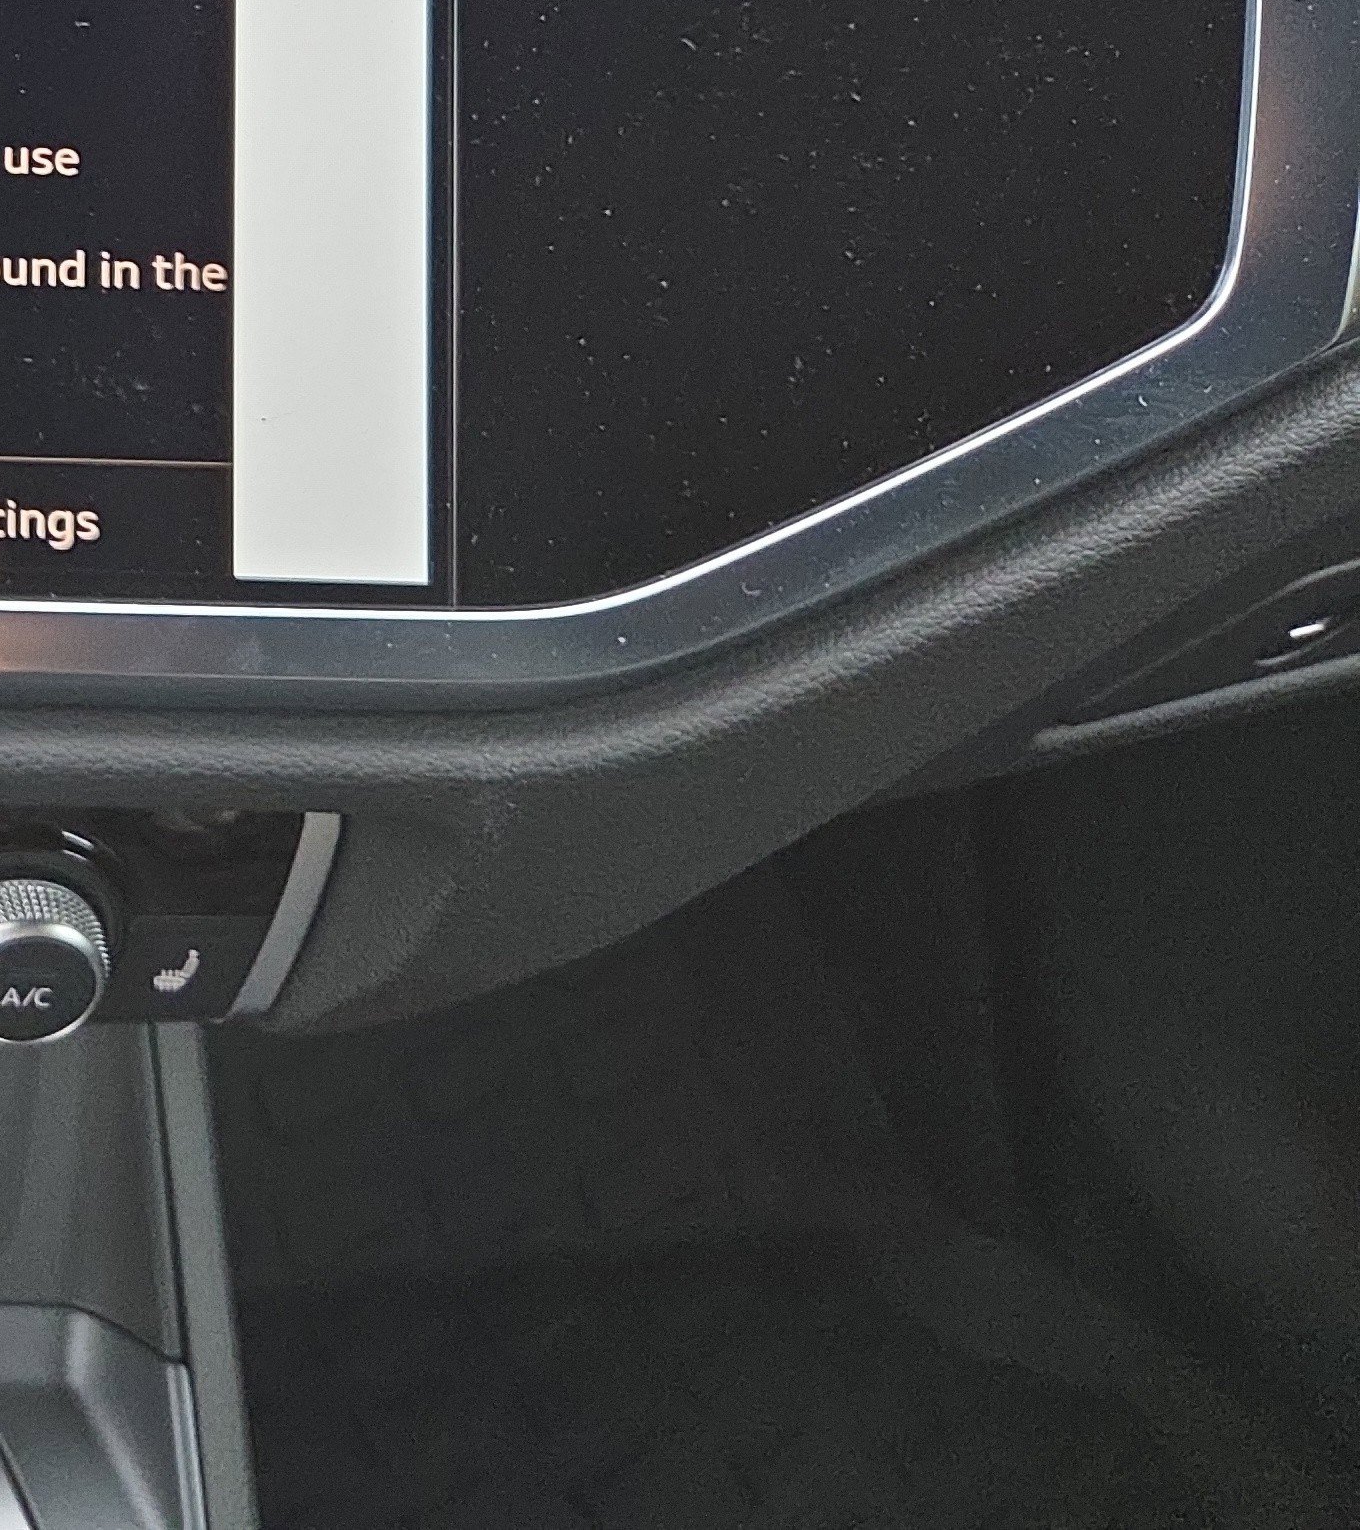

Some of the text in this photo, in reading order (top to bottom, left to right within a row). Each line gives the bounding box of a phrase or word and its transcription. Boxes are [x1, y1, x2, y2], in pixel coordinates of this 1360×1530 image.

[3, 146, 81, 177] use
[100, 250, 140, 290] in
[151, 251, 228, 292] the
[0, 986, 52, 1009] A/C
